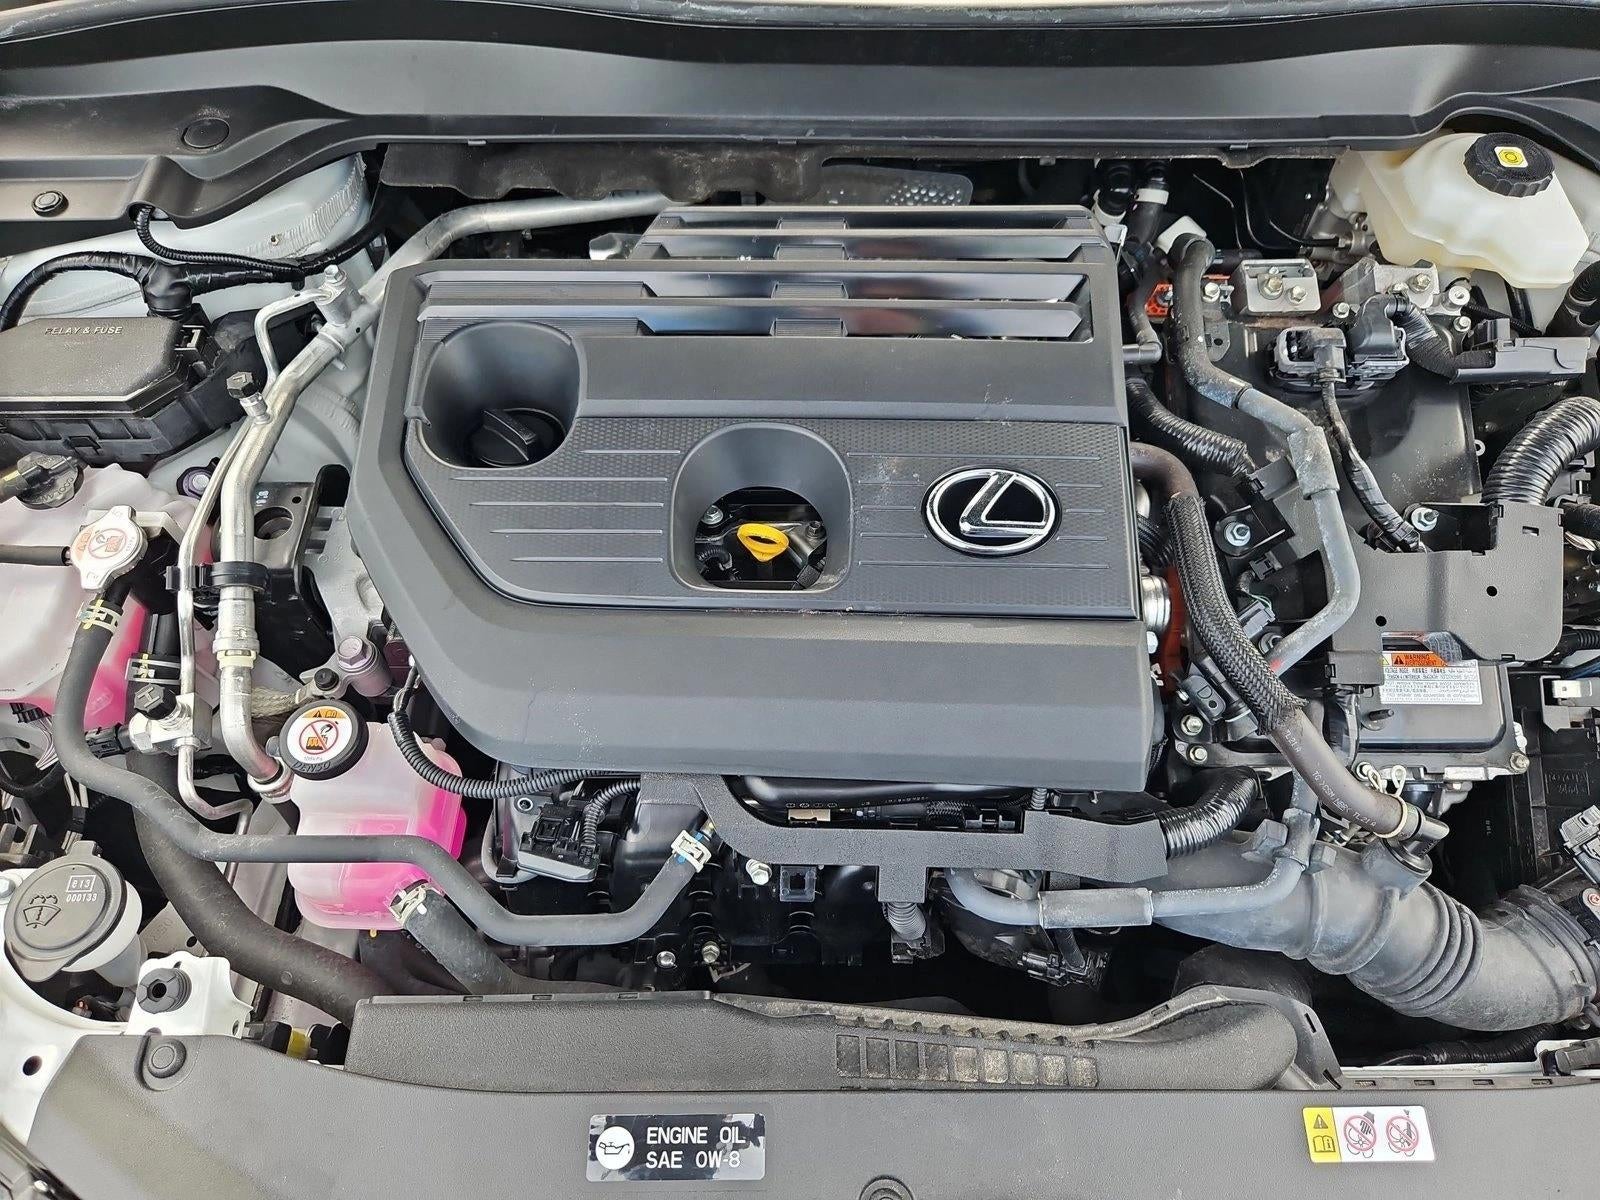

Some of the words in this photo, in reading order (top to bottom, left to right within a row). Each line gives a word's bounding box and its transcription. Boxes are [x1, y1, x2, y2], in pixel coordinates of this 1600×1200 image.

[93, 326, 123, 335] FUSE
[292, 761, 331, 773] DENSO
[646, 1126, 708, 1145] ENGINE
[719, 1126, 746, 1144] OIL
[645, 1150, 684, 1169] SAE
[695, 1150, 741, 1169] 0W-8
